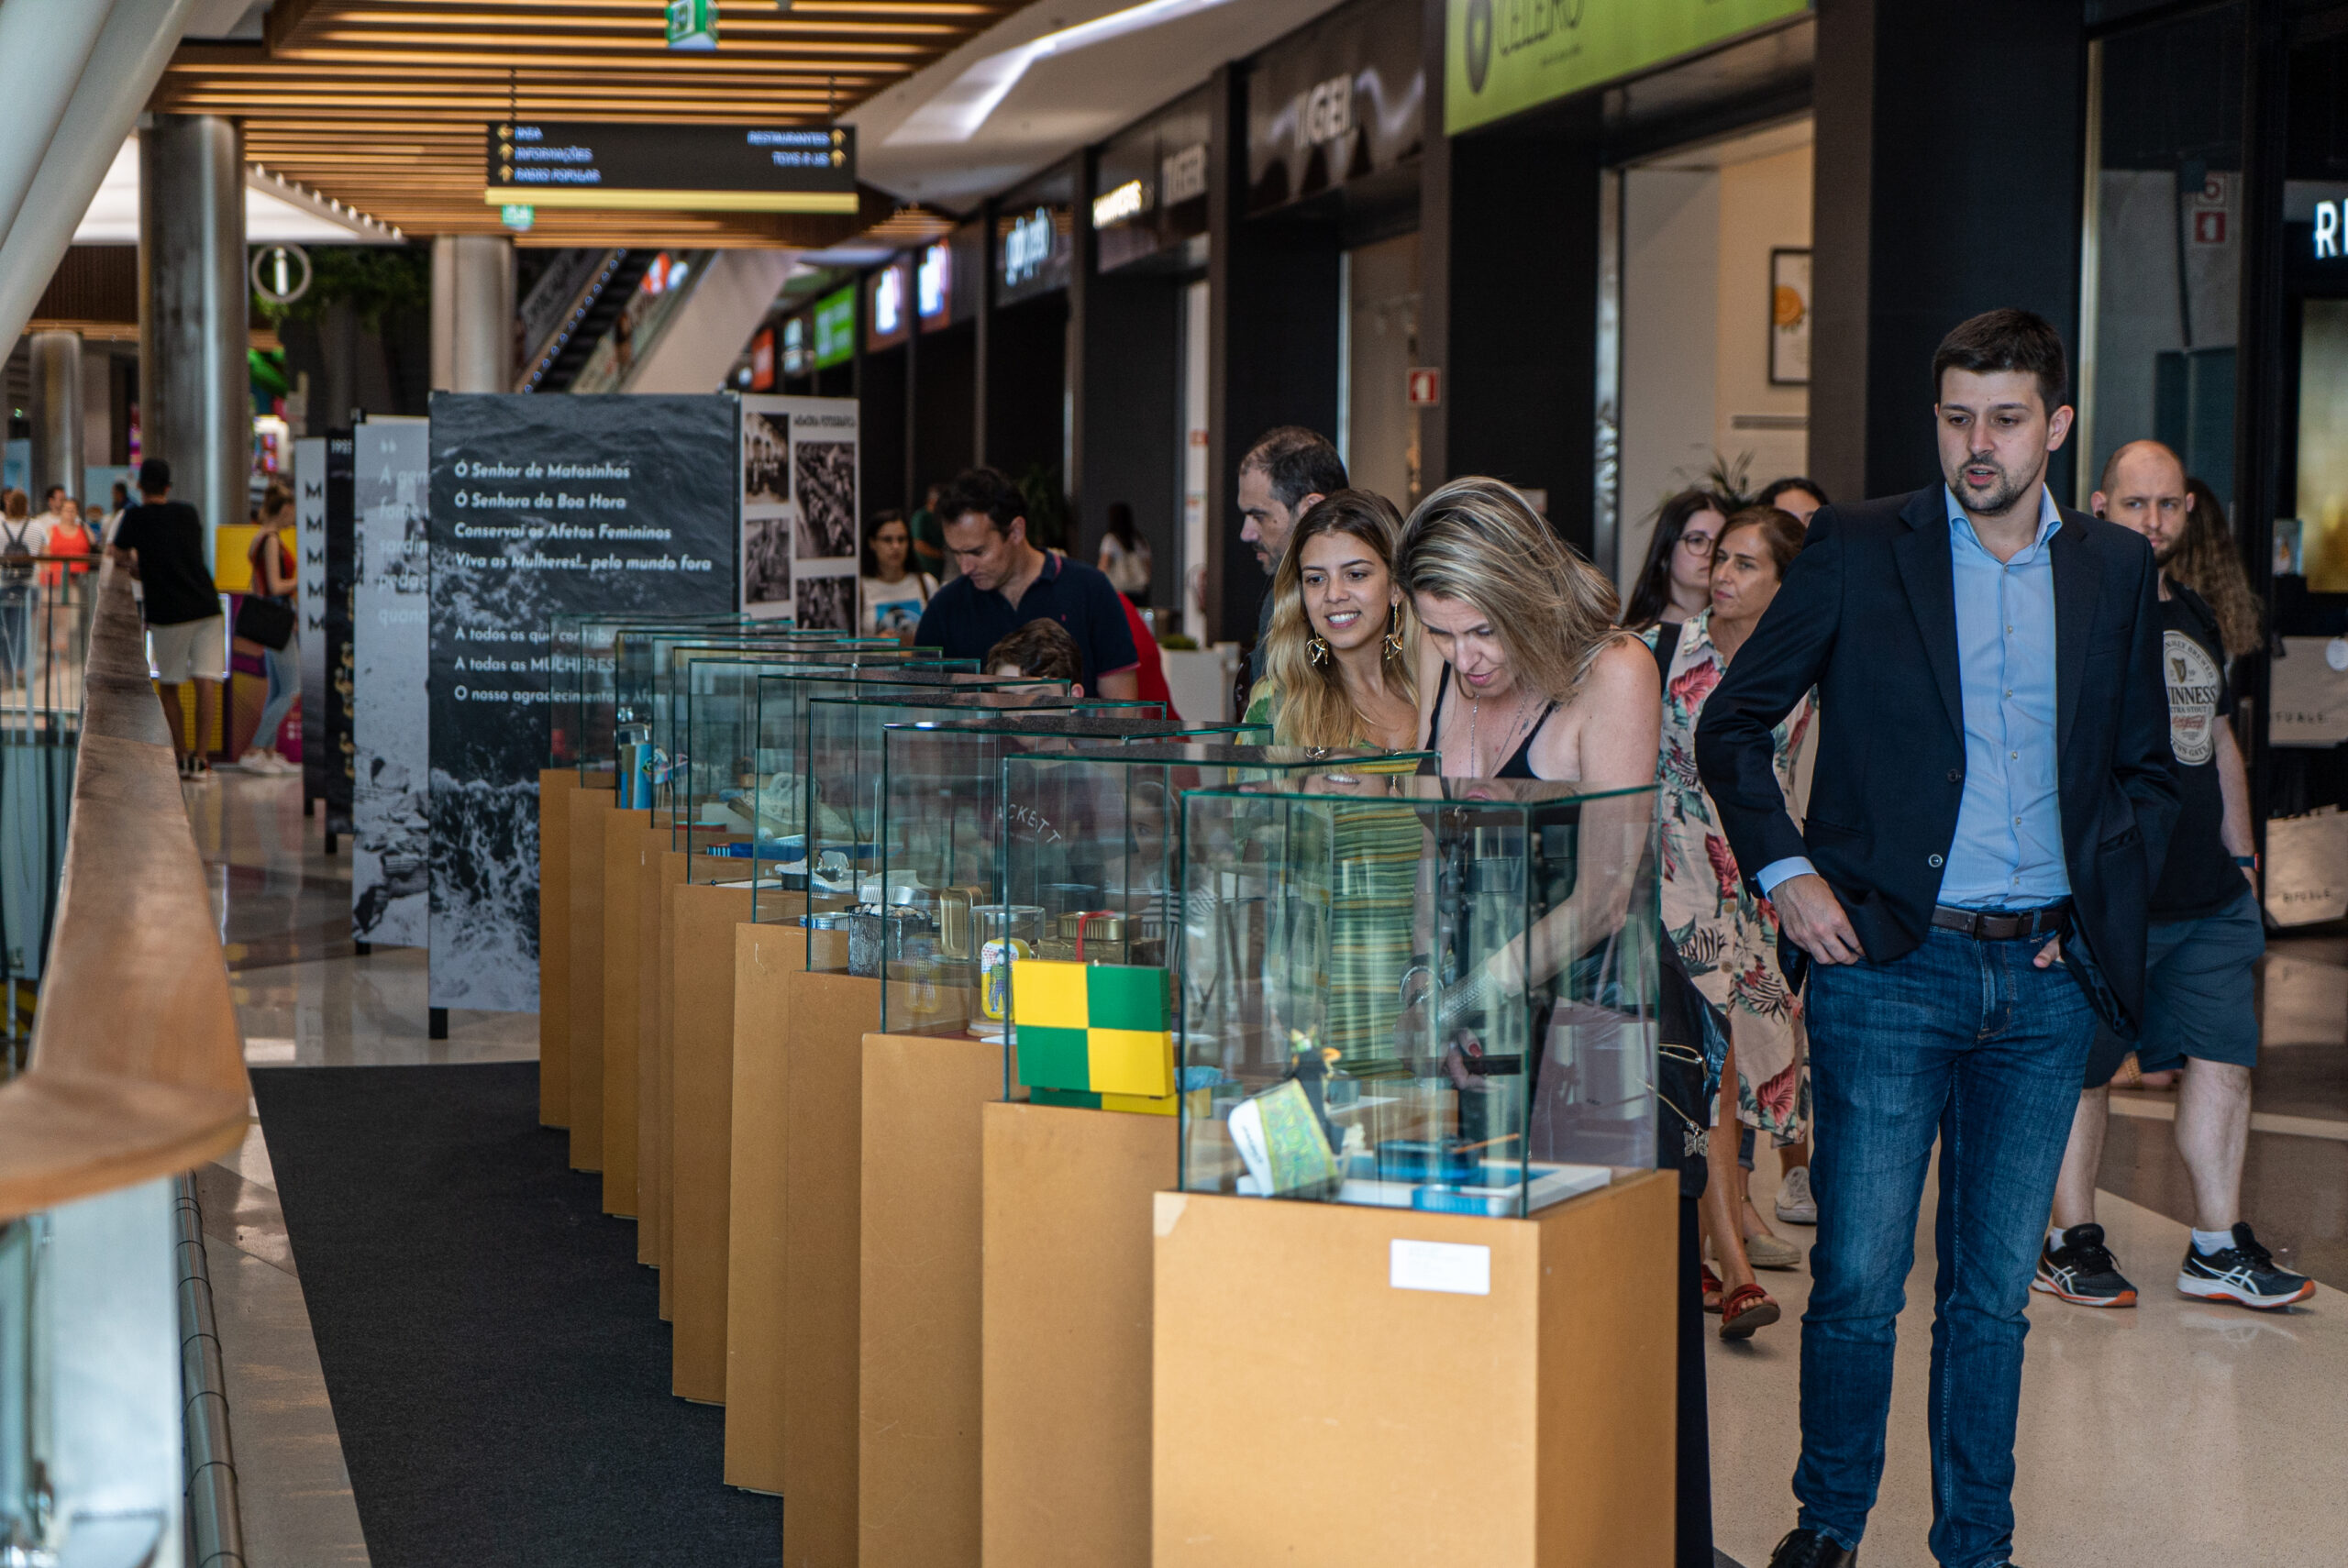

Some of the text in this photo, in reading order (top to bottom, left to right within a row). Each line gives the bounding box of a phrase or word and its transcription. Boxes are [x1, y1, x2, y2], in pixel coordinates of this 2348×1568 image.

[471, 461, 521, 478] Senhor
[525, 461, 543, 478] de
[548, 462, 630, 480] Matosinhos
[471, 491, 530, 509] Senhora
[535, 491, 553, 509] da
[558, 492, 585, 509] Boa
[590, 492, 626, 509] Hora
[455, 522, 671, 540] Conservai os Afetos Femininos
[455, 552, 486, 568] Viva
[491, 556, 507, 569] as
[591, 553, 623, 572] pelo
[626, 554, 676, 570] mundo
[681, 554, 712, 571] fora
[455, 626, 466, 642] A
[470, 626, 505, 642] todos
[510, 630, 525, 642] os
[455, 655, 616, 673] A todas as MULHERES
[455, 685, 468, 701] O
[471, 690, 508, 702] nosso
[2167, 685, 2216, 705] INNESS
